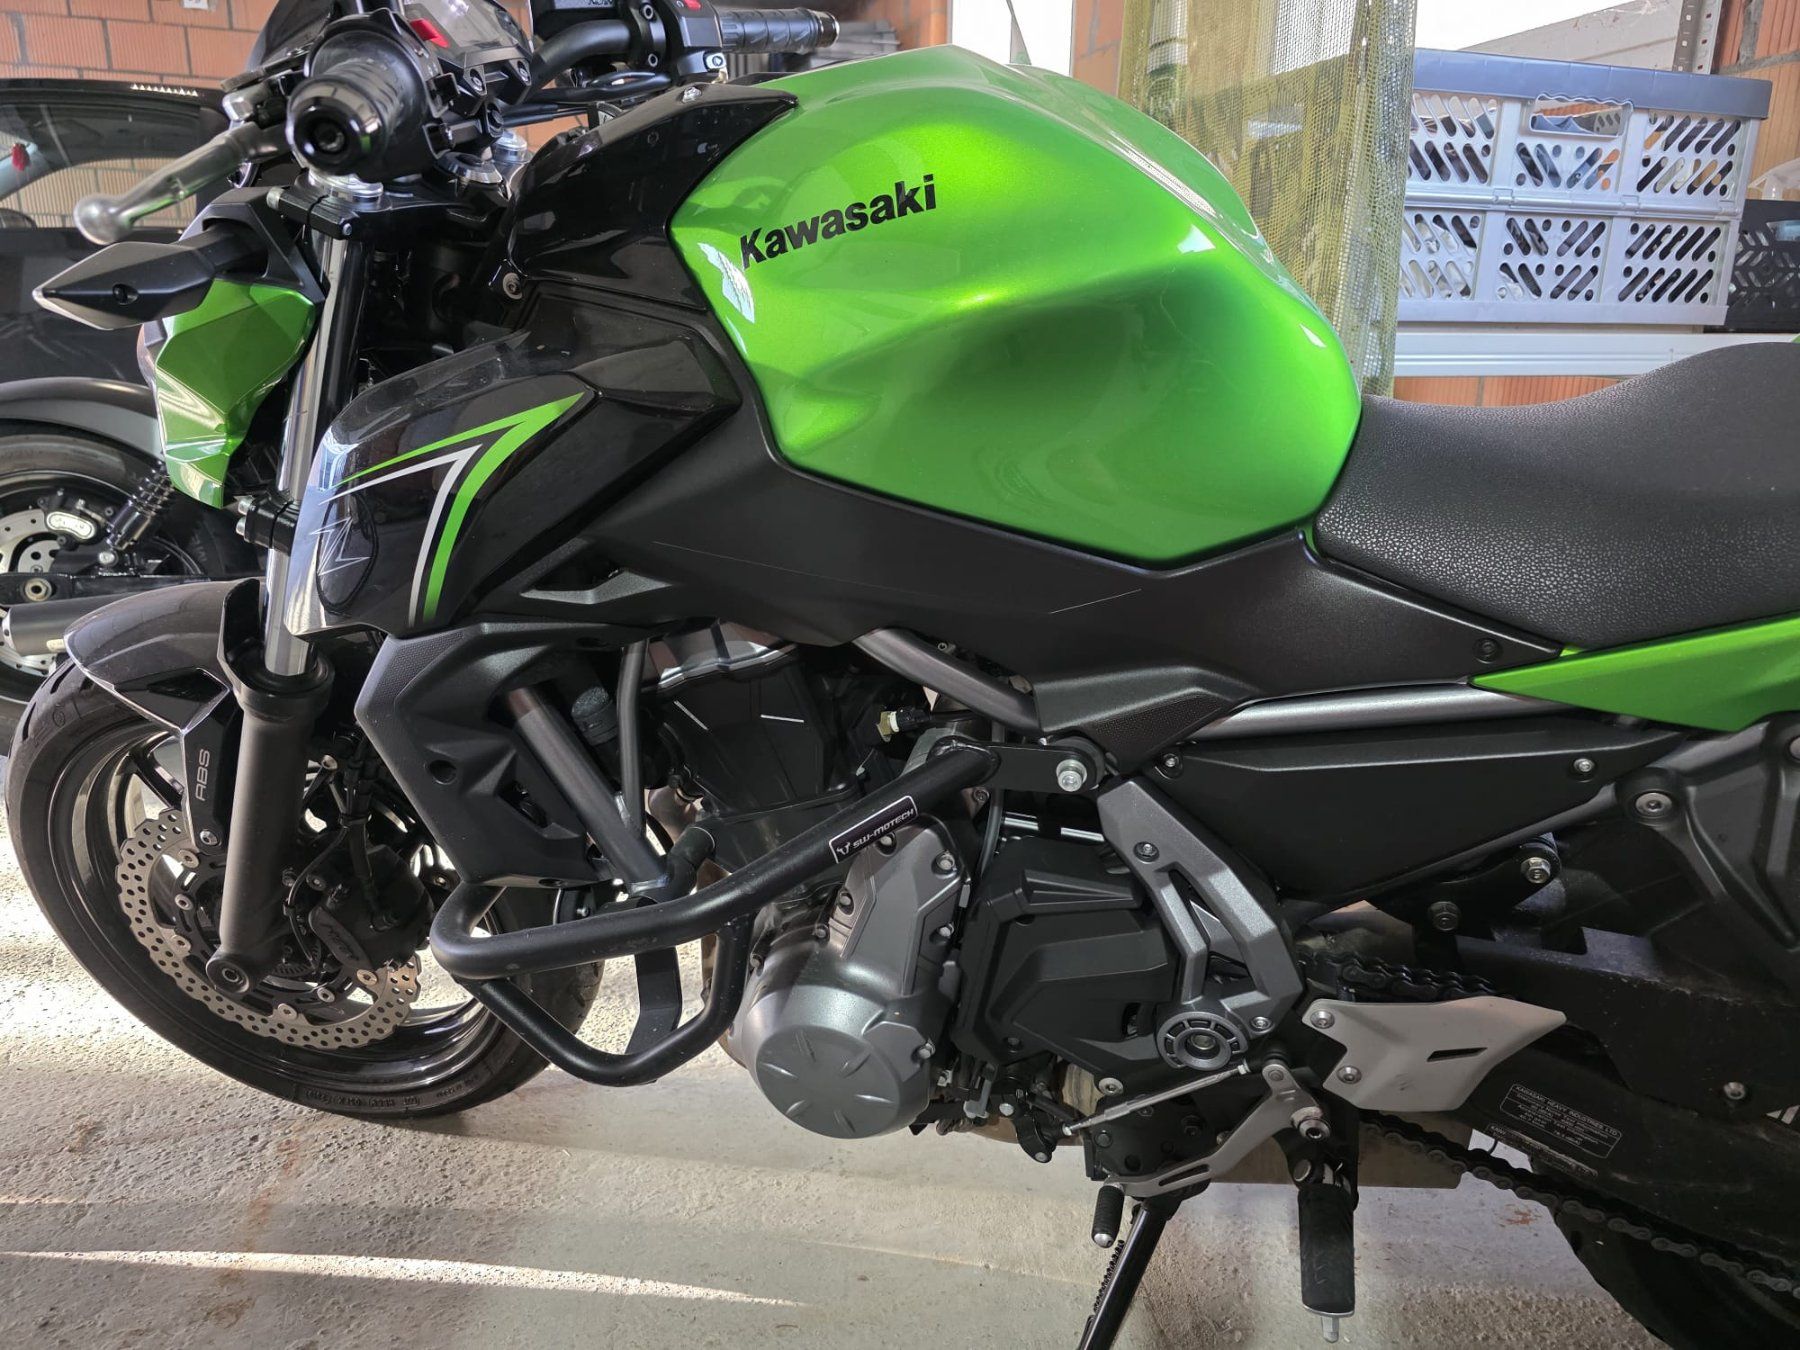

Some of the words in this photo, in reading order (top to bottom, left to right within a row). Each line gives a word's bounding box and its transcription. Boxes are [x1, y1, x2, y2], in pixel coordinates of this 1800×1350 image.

[740, 174, 937, 270] Kawasaki
[195, 749, 210, 802] ABS
[852, 808, 914, 849] SW-MOTECH
